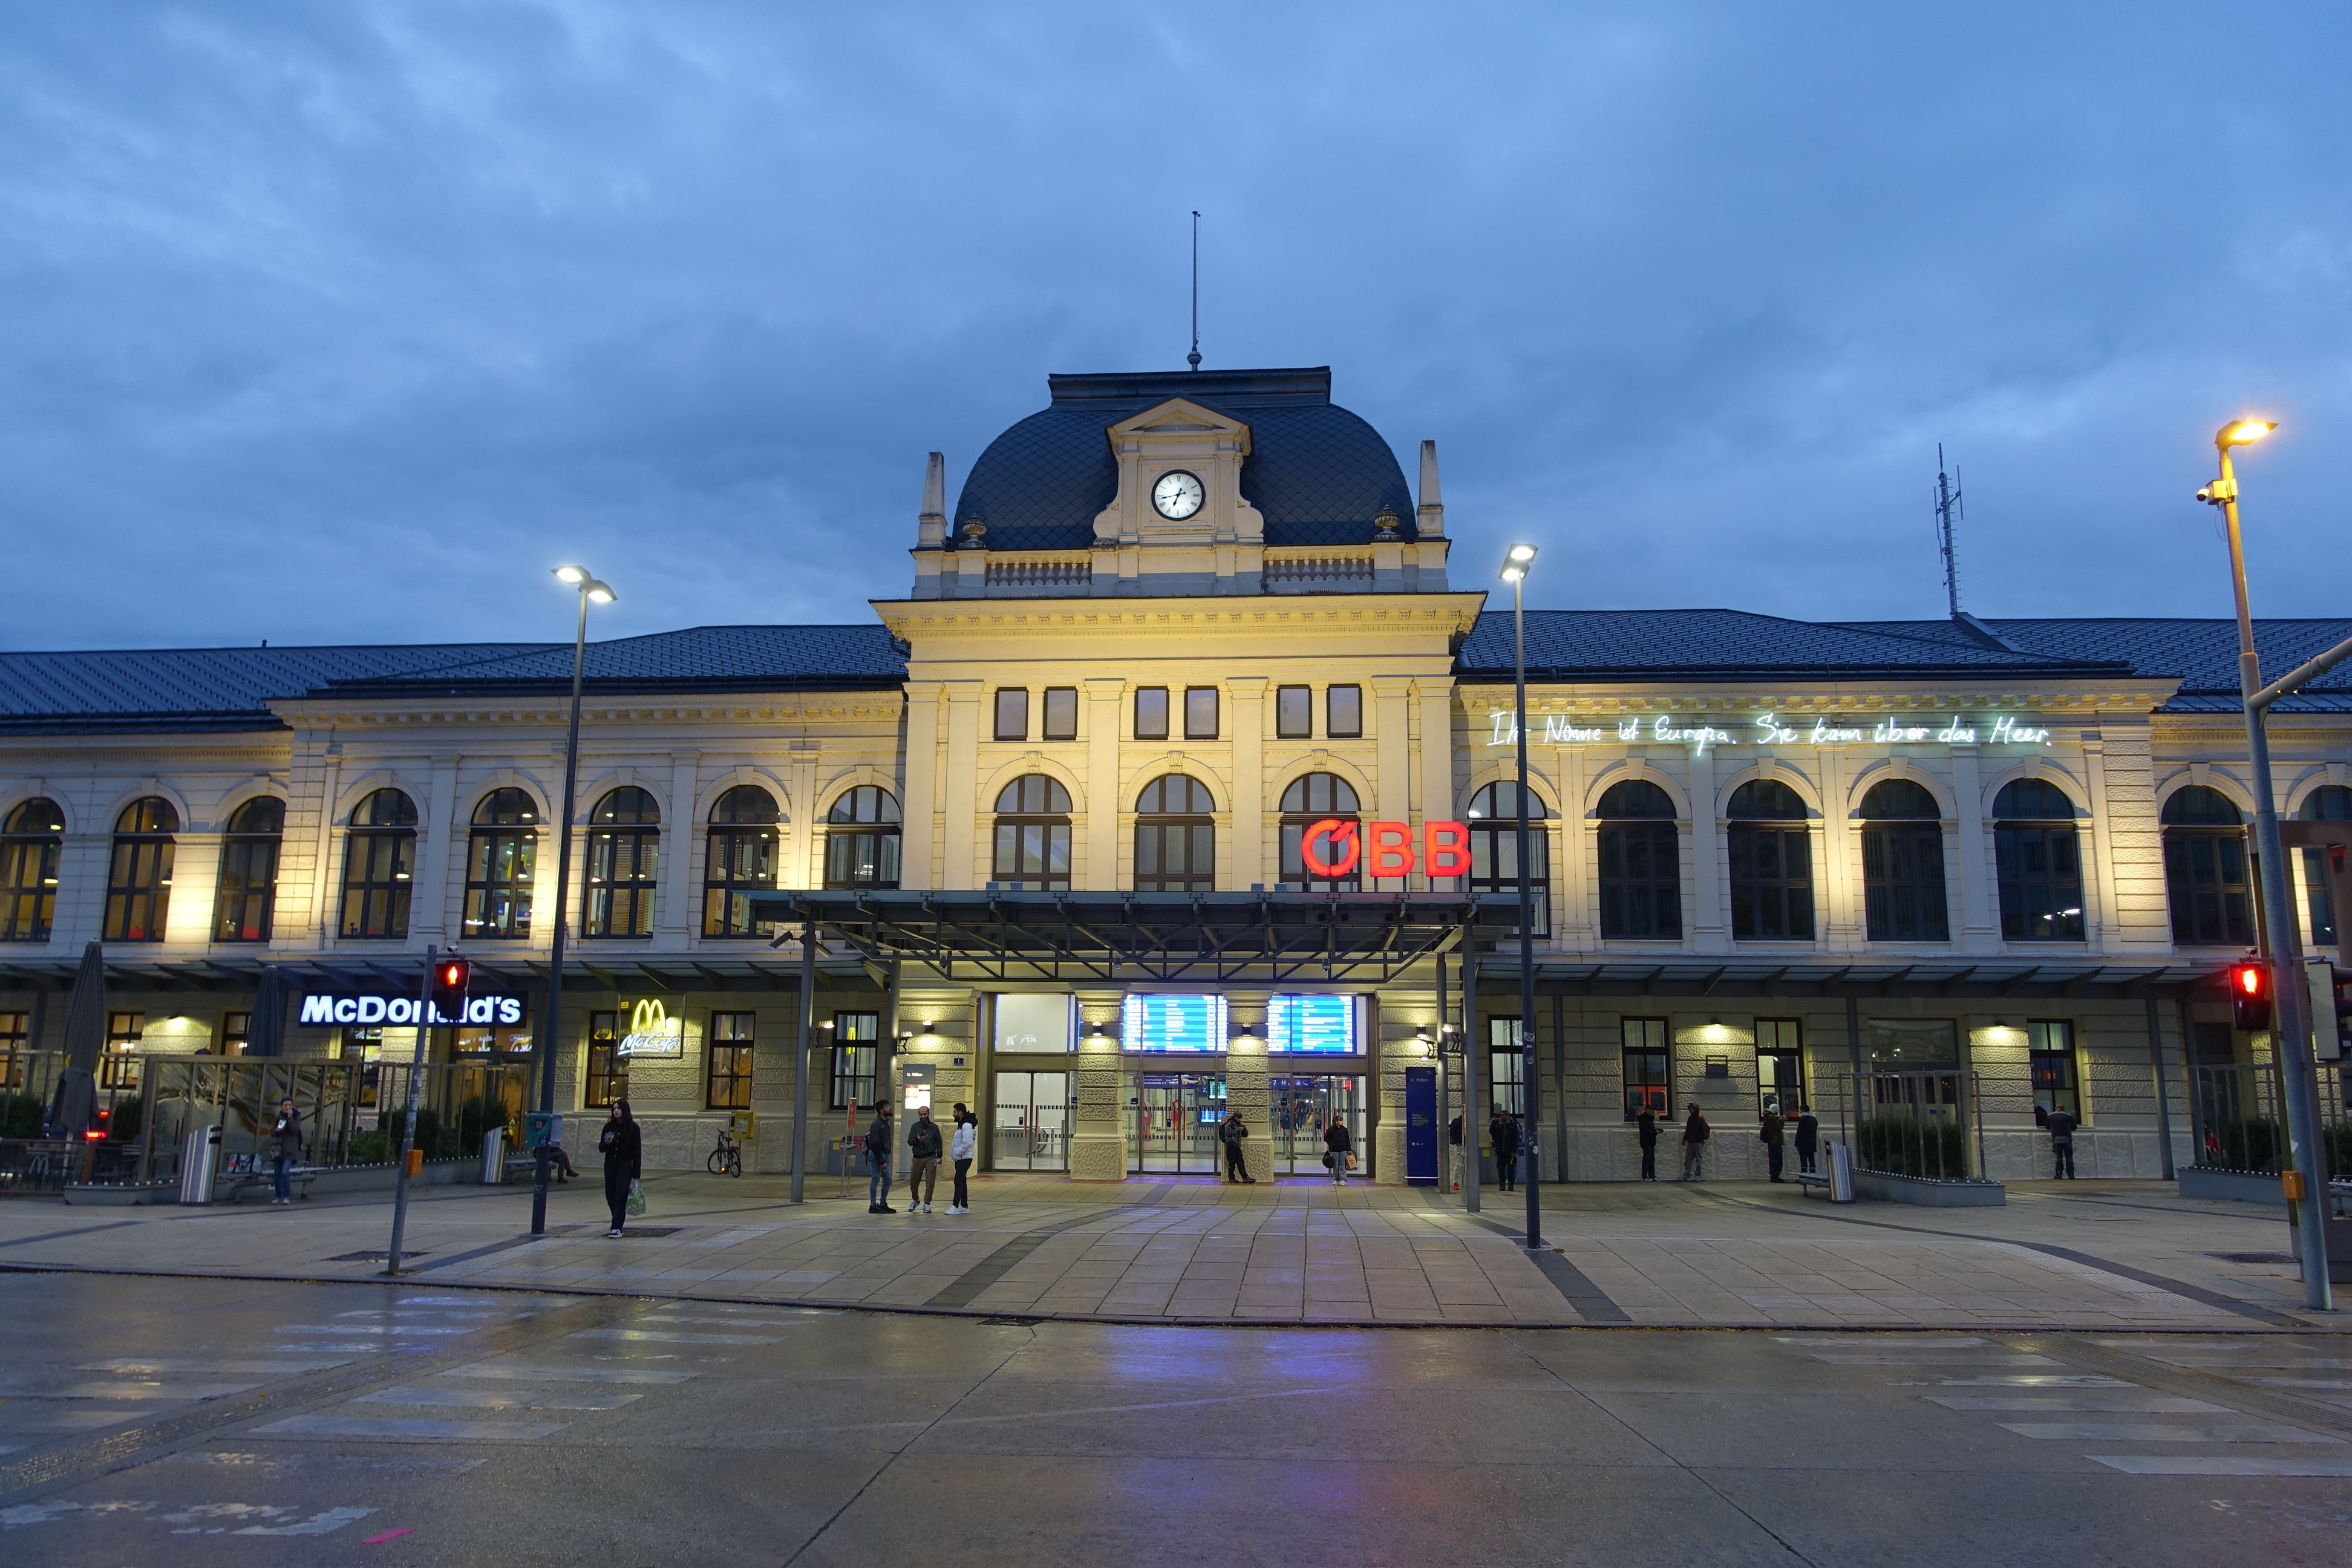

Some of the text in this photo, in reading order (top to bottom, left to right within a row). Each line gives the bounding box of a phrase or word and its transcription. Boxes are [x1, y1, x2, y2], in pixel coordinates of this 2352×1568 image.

[1544, 714, 1601, 743] Name
[1618, 717, 1639, 740] ist
[1655, 716, 1737, 757] Europa.
[1756, 713, 1798, 745] Sie
[1811, 717, 1861, 744] kam
[1875, 716, 1930, 743] über
[1938, 715, 1975, 742] das
[1990, 716, 2053, 746] Meer.
[1302, 819, 1471, 877] ÖBB
[300, 995, 521, 1023] McDond's
